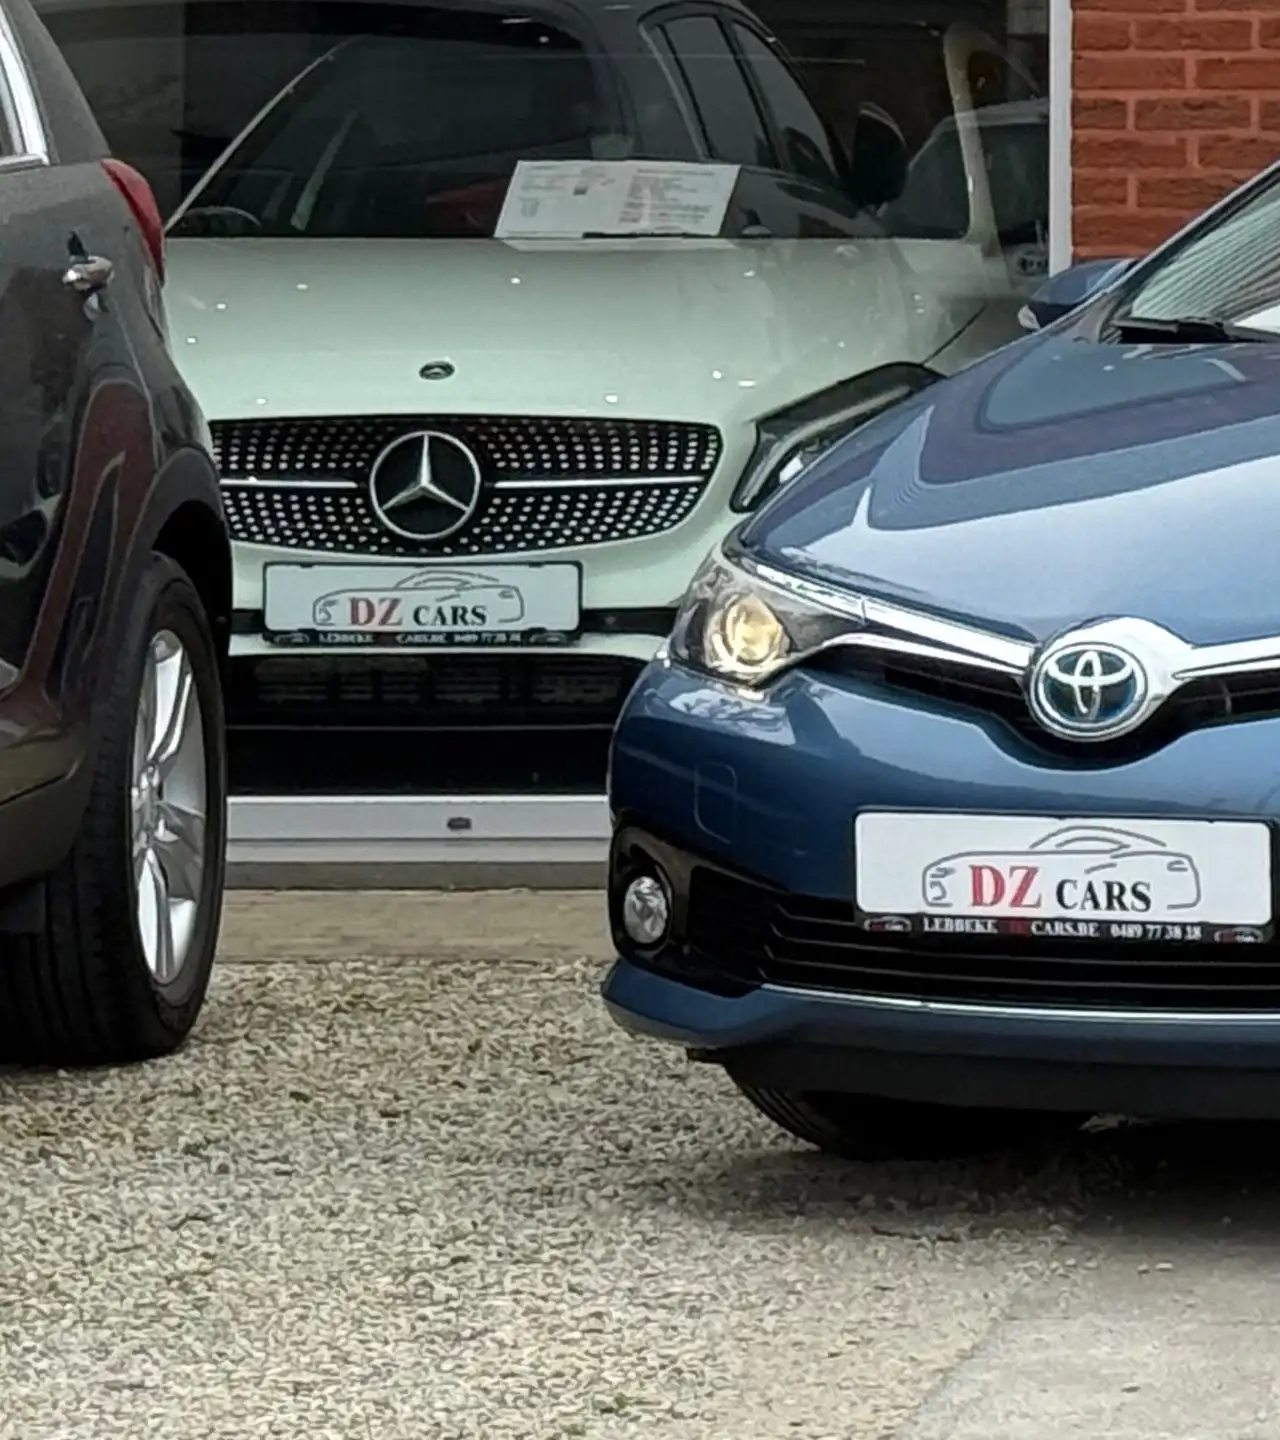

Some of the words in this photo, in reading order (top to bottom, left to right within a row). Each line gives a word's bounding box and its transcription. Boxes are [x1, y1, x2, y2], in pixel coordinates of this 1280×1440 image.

[348, 597, 402, 626] DZ
[413, 605, 487, 627] CARS
[968, 865, 1042, 909] DZ
[1055, 878, 1152, 912] CARS
